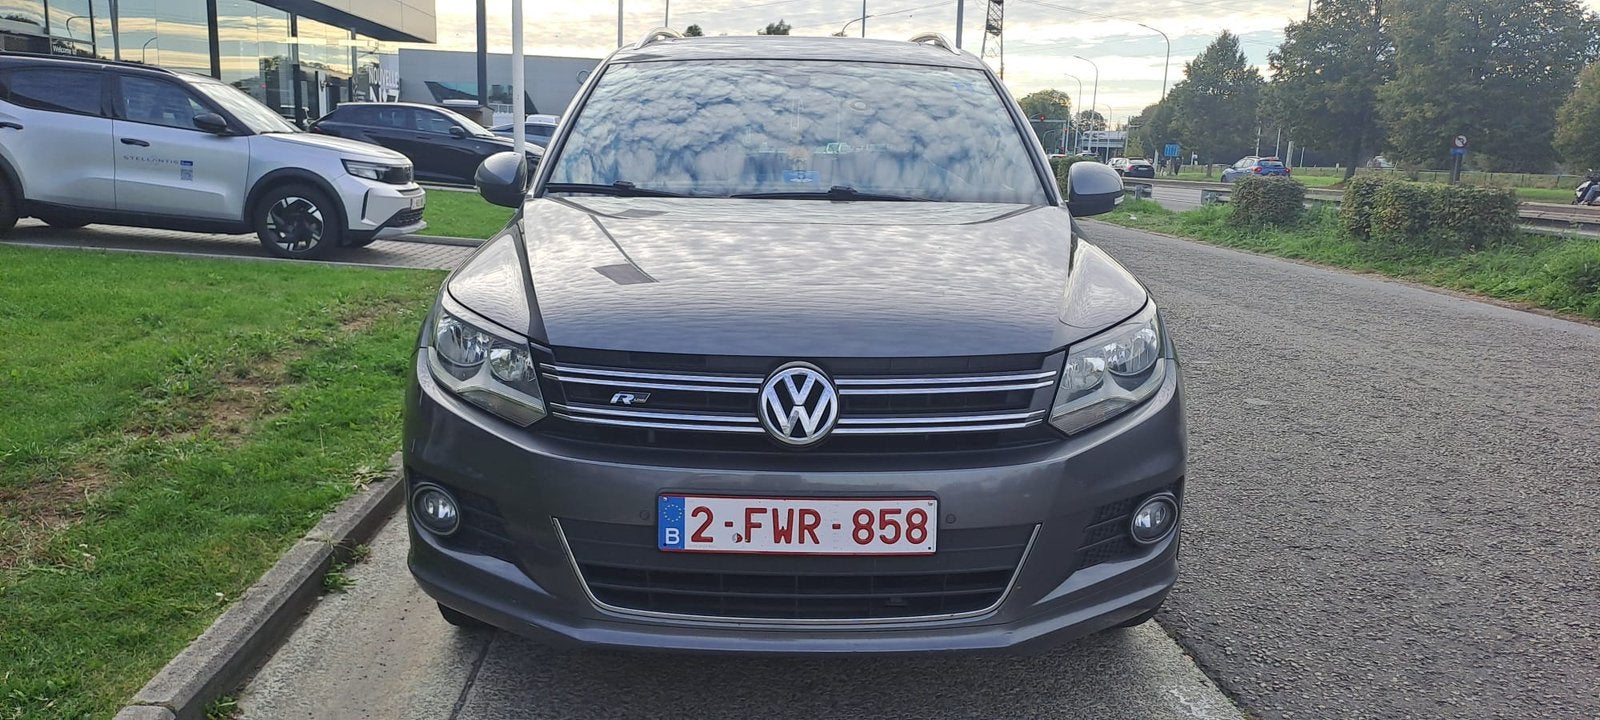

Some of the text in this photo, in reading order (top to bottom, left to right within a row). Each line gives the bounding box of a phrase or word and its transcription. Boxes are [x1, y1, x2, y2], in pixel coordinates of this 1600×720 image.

[369, 66, 399, 90] NOUVELLE
[123, 155, 179, 164] STELLANTIS
[665, 506, 928, 546] B 2-FWR-858
